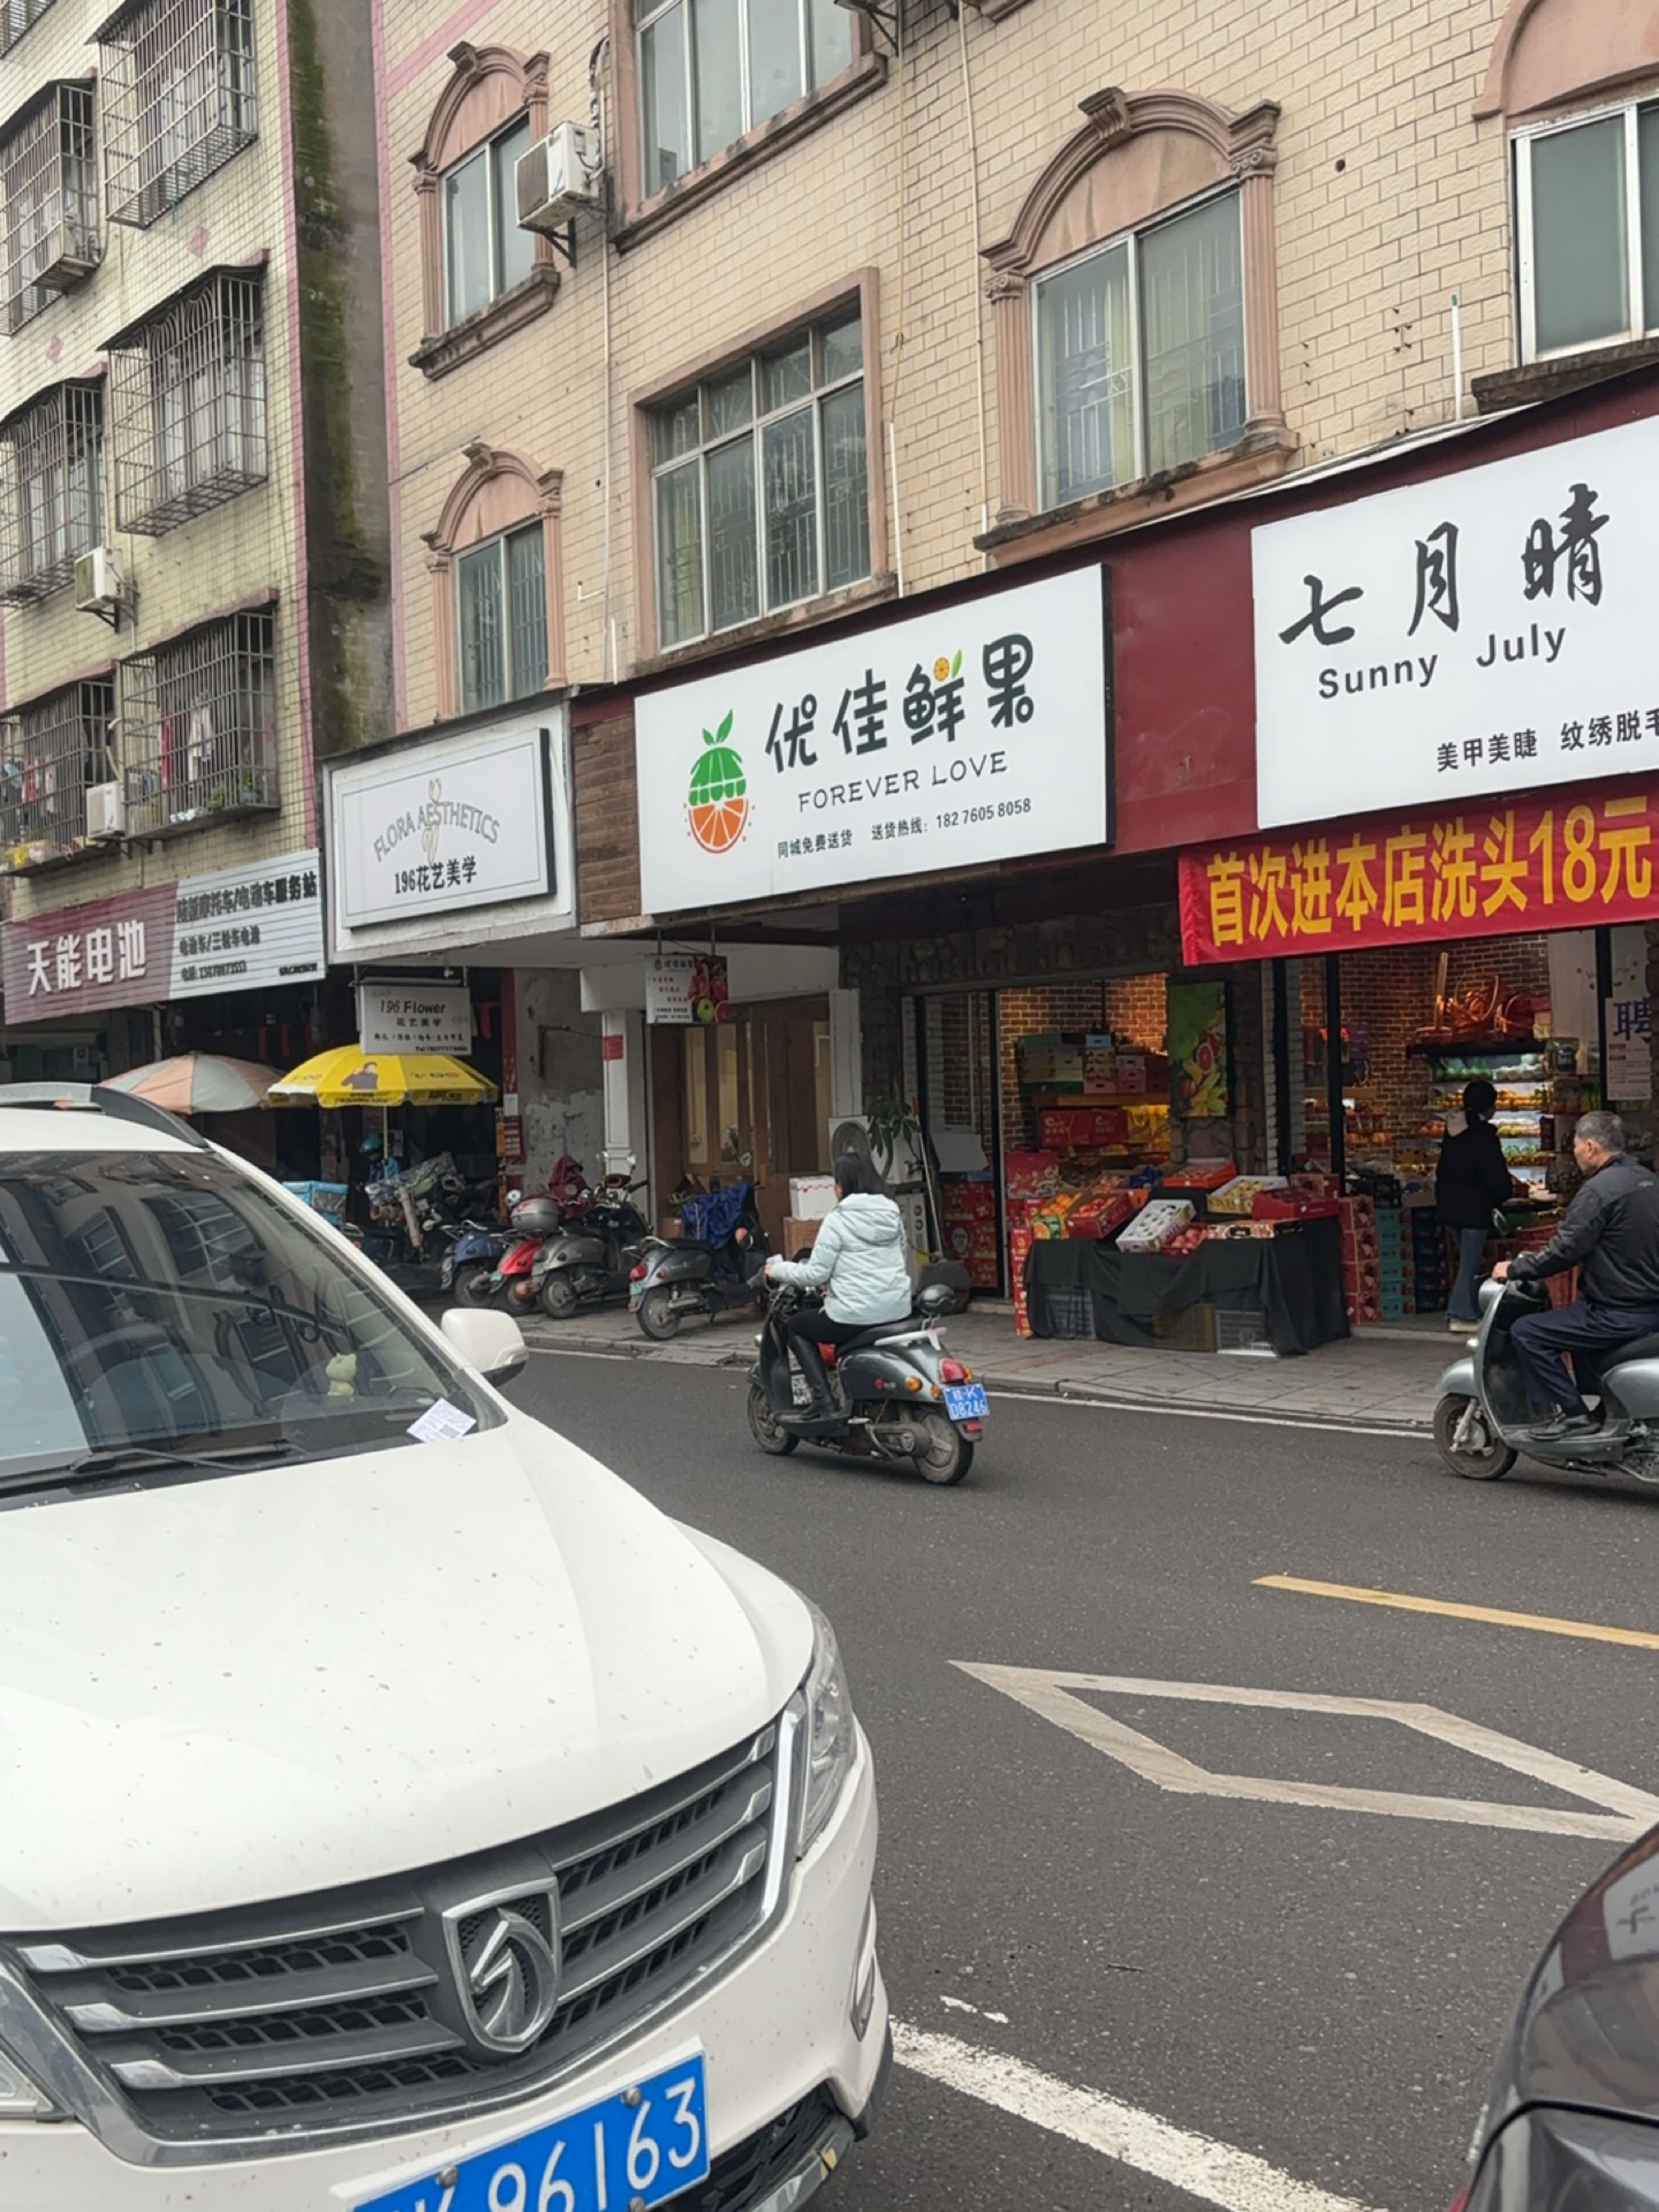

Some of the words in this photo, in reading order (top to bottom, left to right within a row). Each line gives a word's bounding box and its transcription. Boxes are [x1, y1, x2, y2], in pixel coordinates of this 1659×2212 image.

[1278, 483, 1610, 646] 七月晴
[1318, 654, 1438, 699] Sunny
[1476, 623, 1566, 668] July
[765, 633, 1034, 774] 优佳鲜果
[1437, 728, 1538, 773] 美甲美睫
[798, 769, 920, 812] FOREVER
[932, 751, 1007, 786] LOVE
[374, 812, 416, 862] FLORA
[419, 801, 500, 844] AESTHETICS
[778, 828, 853, 859] 同城免费送货
[395, 856, 477, 894] 196花艺美学
[1207, 795, 1653, 947] 首次进本店洗头18元
[27, 919, 148, 996] 天能电池
[380, 999, 401, 1014] 196
[403, 1000, 447, 1014] Flower
